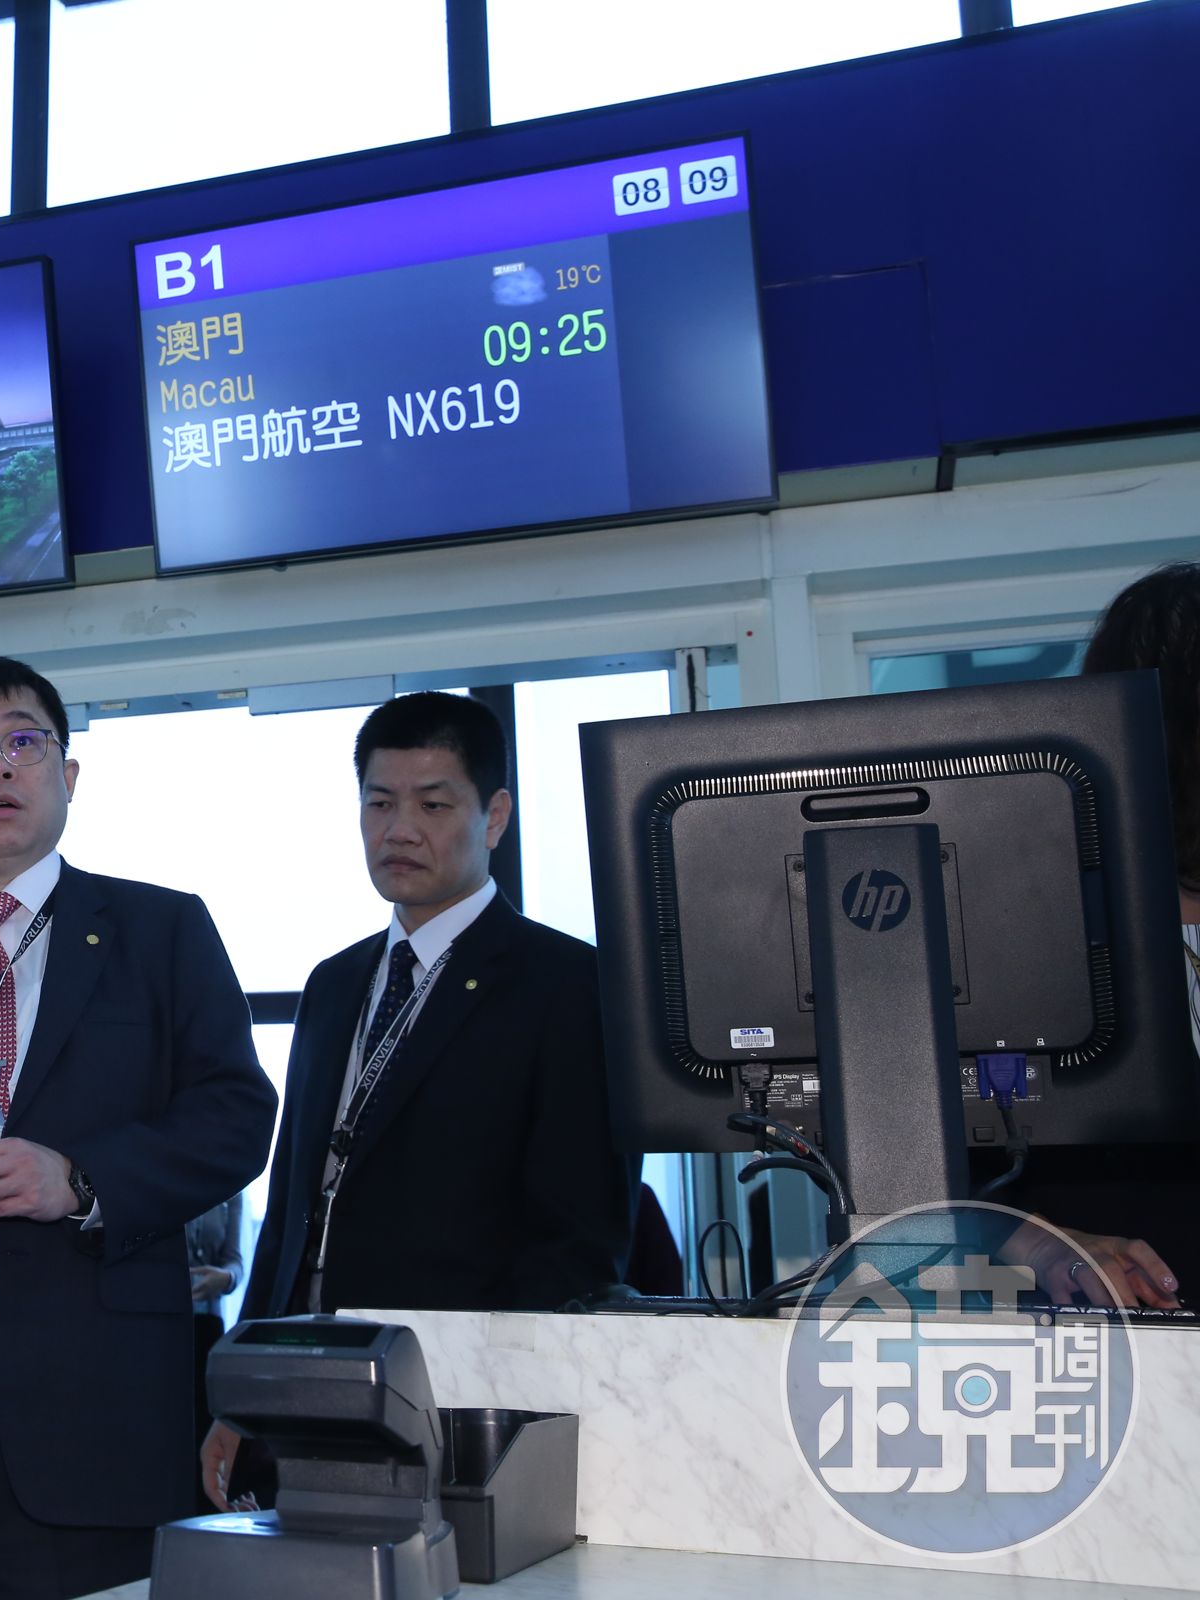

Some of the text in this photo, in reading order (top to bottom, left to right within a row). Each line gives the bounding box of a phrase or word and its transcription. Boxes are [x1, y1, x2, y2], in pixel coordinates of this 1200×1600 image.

[622, 166, 728, 207] 08 09
[155, 244, 225, 300] B1
[156, 312, 244, 367] 澳門
[483, 308, 607, 367] 09:25
[159, 374, 255, 414] Macau
[162, 379, 521, 473] 澳門航空 NX619
[848, 868, 906, 932] hp
[14, 913, 48, 962] STARLUX
[414, 950, 452, 1000] STARLUX
[740, 1028, 765, 1036] SITA
[360, 1038, 395, 1091] STARLUX
